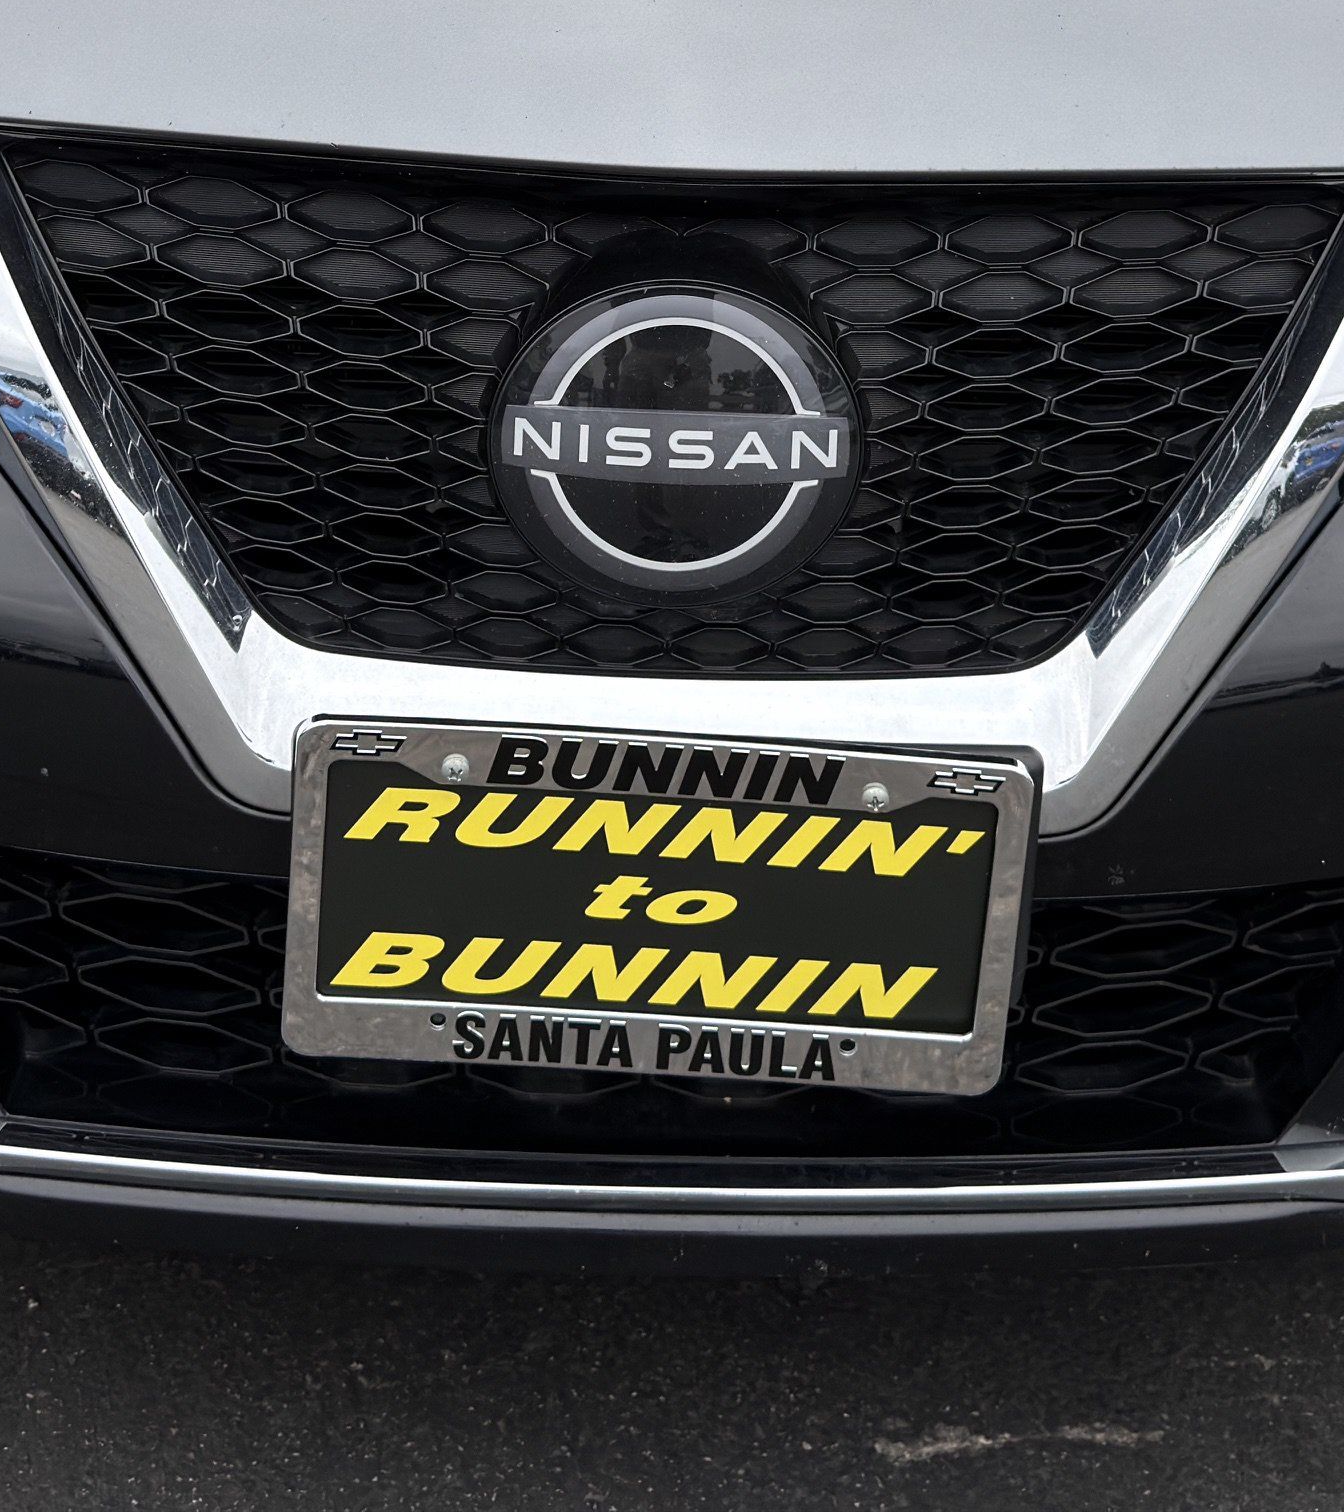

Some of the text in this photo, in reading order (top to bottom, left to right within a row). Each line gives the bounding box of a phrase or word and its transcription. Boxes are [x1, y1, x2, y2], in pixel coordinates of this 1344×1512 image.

[513, 416, 839, 470] NISSAN
[486, 734, 847, 807] BUNNIN
[343, 786, 987, 878] RUNNIN'
[584, 874, 739, 925] to
[329, 930, 939, 1020] BUNNIN
[452, 1010, 837, 1082] SANTA PAULA
